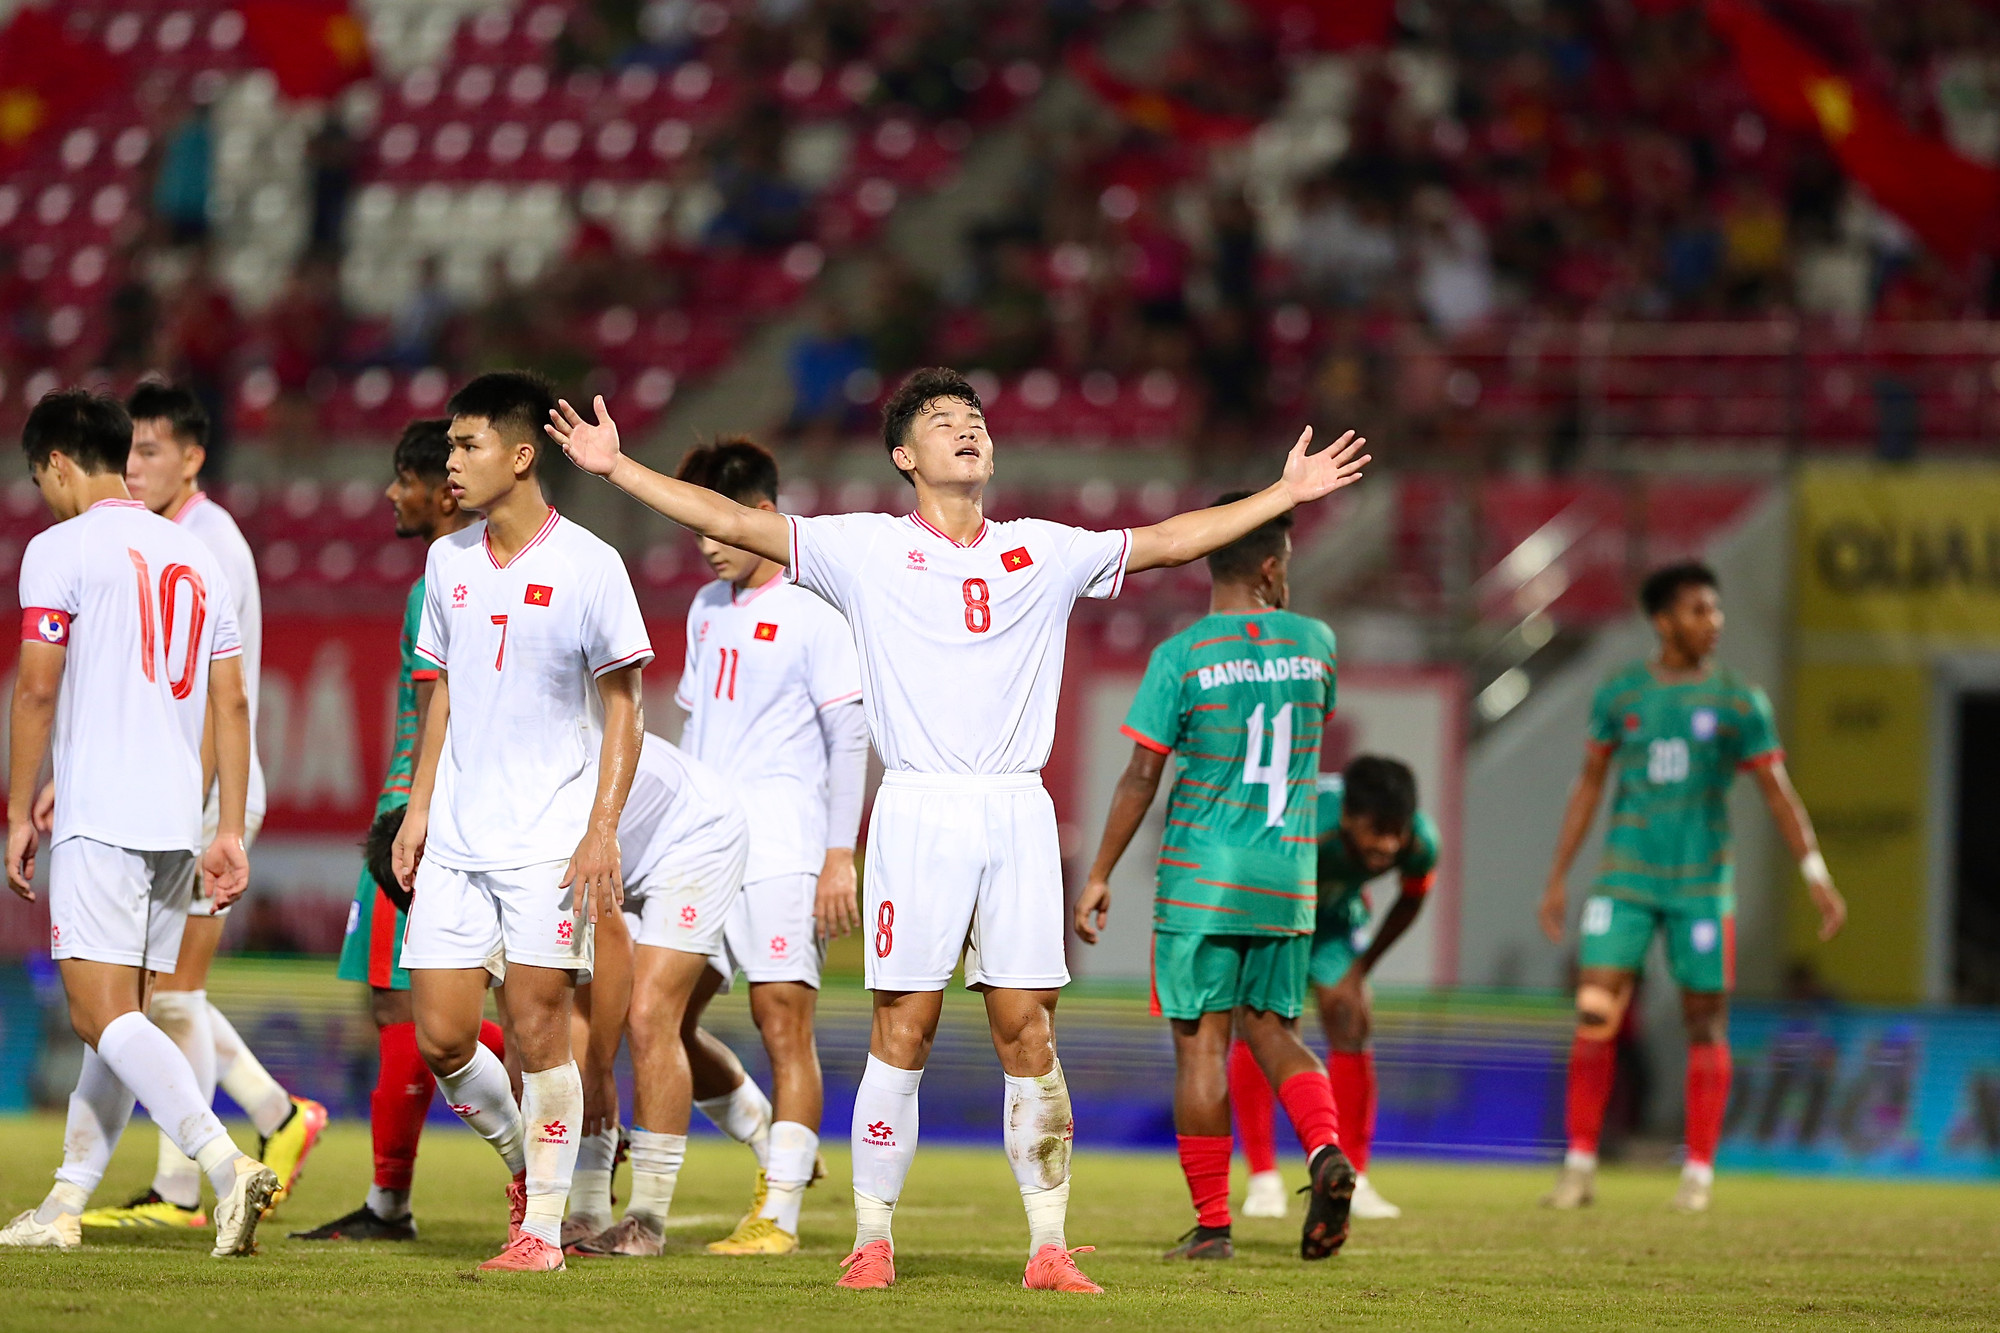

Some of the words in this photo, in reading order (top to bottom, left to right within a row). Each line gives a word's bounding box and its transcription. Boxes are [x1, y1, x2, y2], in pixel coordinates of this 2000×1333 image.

[128, 547, 206, 700] 10
[962, 577, 991, 634] 8
[490, 614, 508, 672] 7
[715, 647, 738, 701] 11
[1198, 655, 1325, 690] BANGLADESH
[1242, 702, 1294, 828] 4
[876, 900, 895, 958] 8
